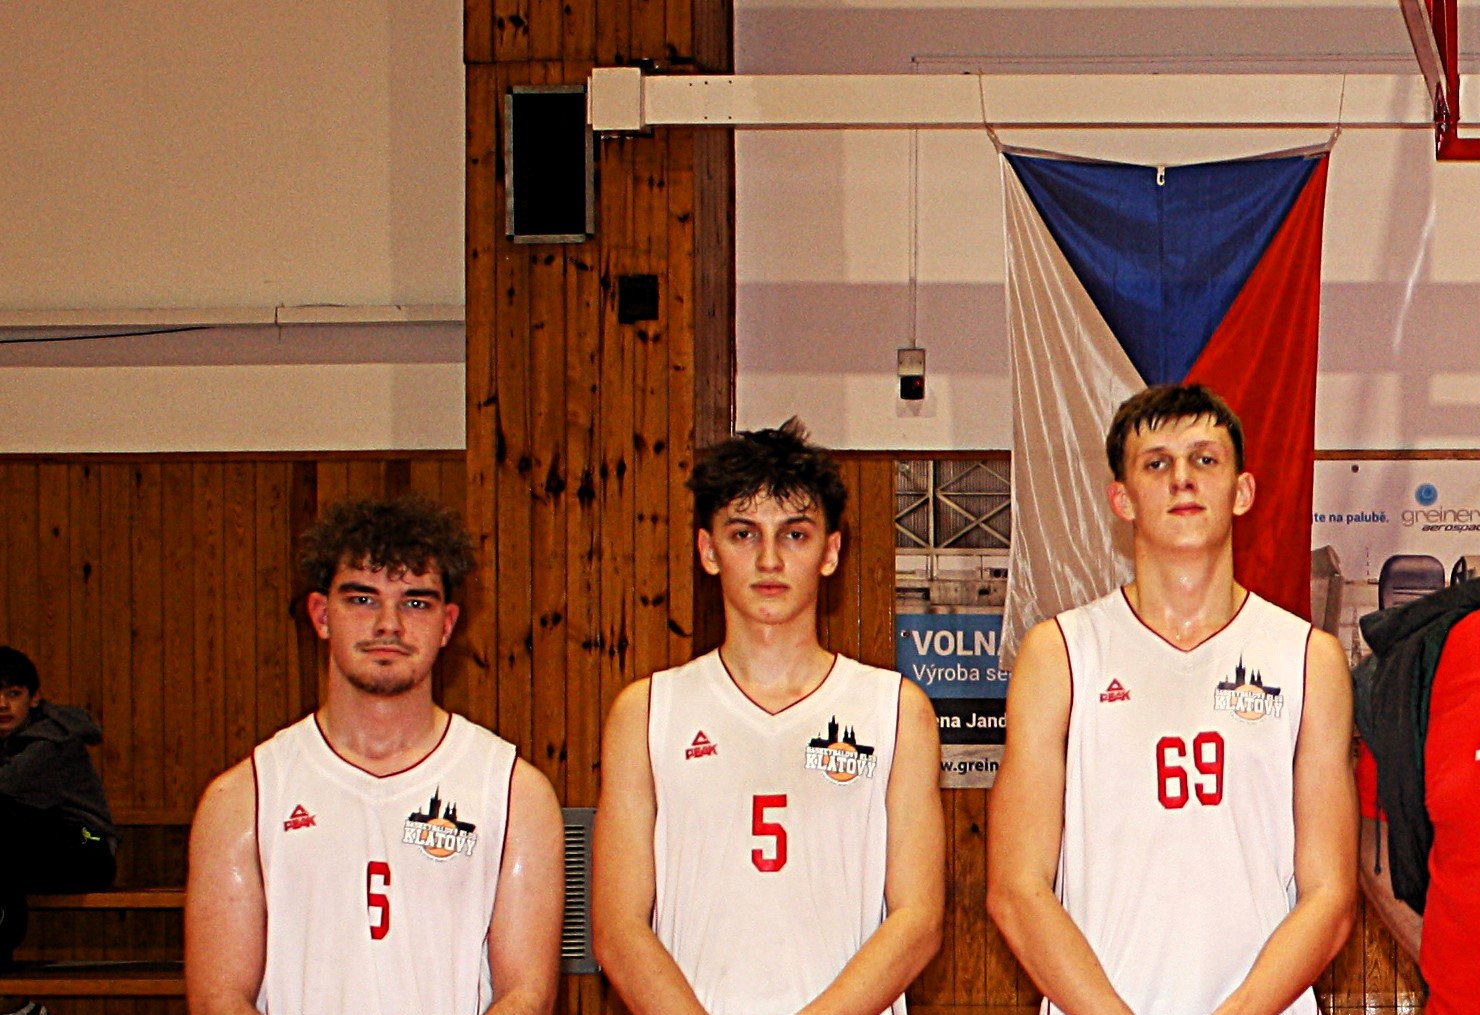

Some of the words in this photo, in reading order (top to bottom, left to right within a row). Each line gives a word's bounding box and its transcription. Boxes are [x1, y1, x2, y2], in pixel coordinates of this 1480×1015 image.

[1329, 514, 1343, 522] na
[1346, 511, 1389, 524] palubě.
[1401, 506, 1480, 527] greiner
[911, 630, 1001, 656] VOLN
[912, 664, 980, 686] Výroba
[986, 668, 1011, 682] se
[804, 753, 878, 778] KLATOVY
[1155, 731, 1224, 810] 69
[402, 827, 477, 857] KLATOVY
[751, 794, 788, 873] 5
[367, 860, 391, 940] 6
